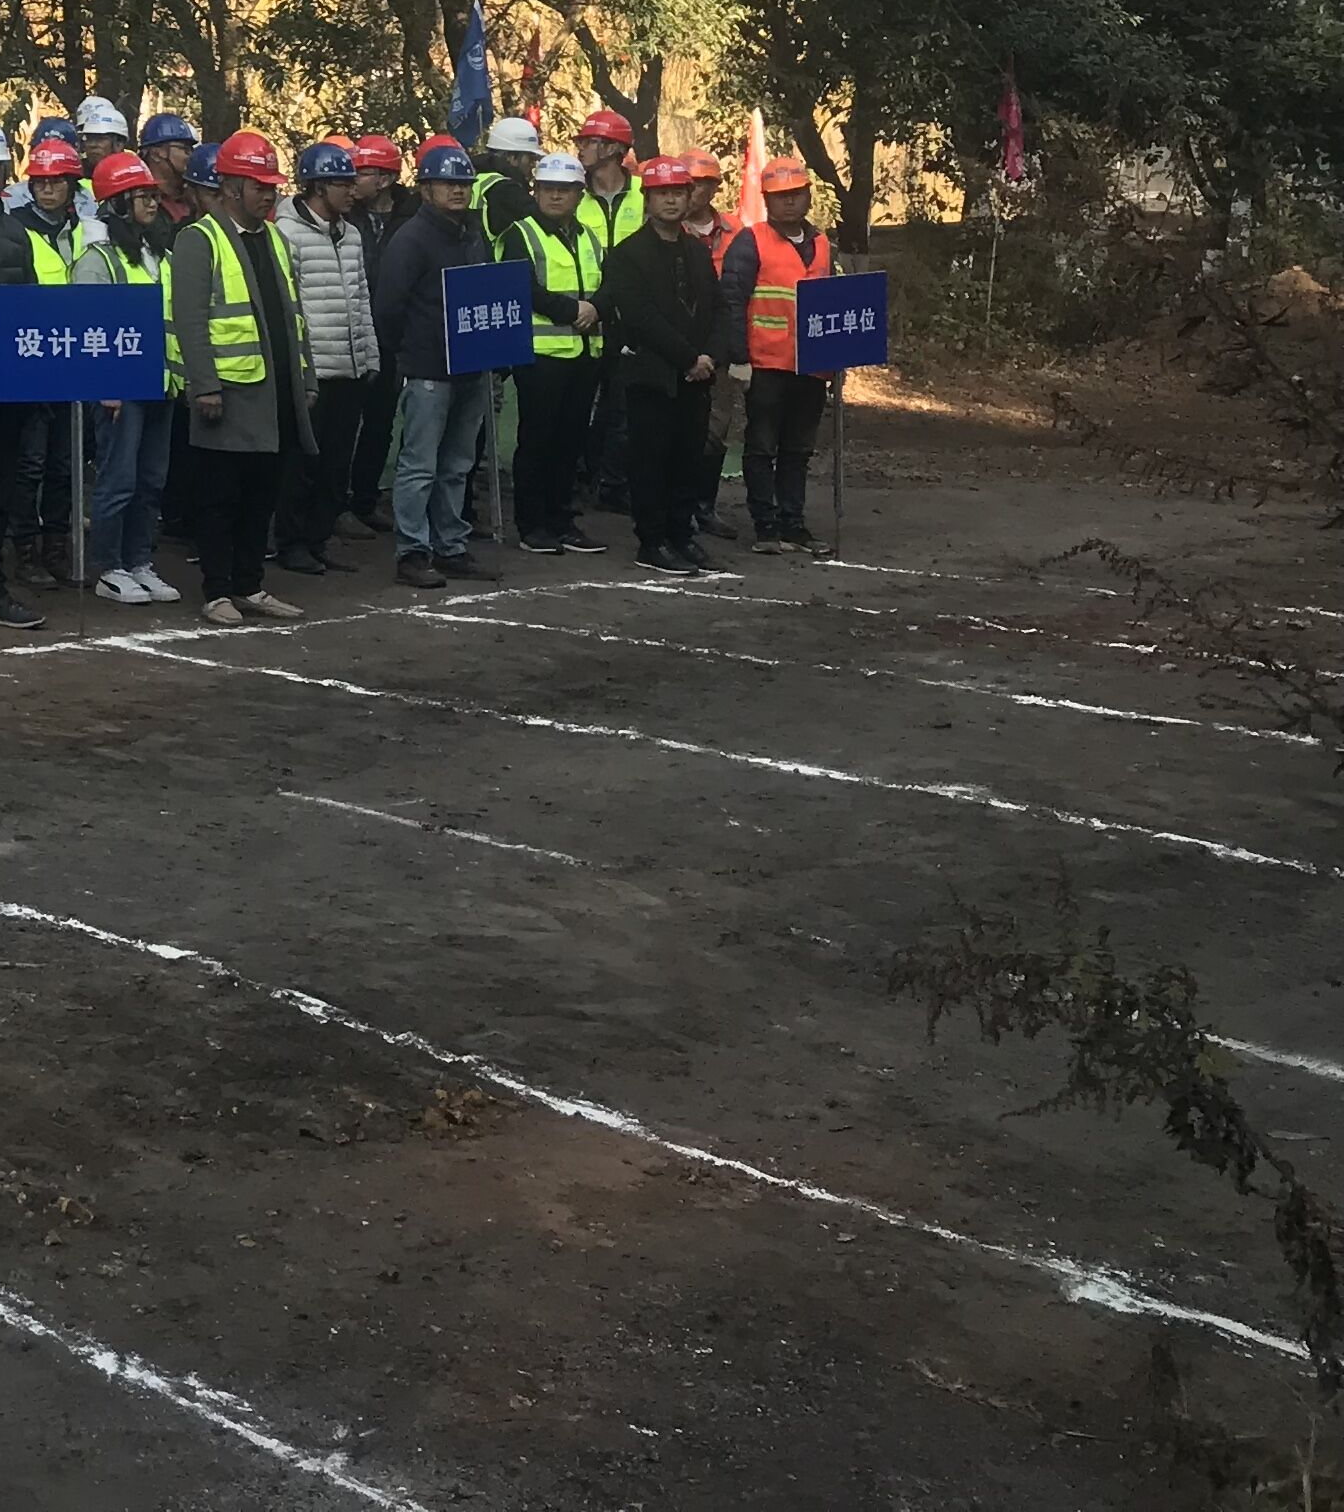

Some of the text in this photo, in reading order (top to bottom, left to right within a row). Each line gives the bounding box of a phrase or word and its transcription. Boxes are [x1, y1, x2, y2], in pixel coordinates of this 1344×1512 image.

[457, 299, 523, 334] 监理单位
[807, 307, 876, 338] 施工单位
[14, 326, 144, 358] 设计单位
